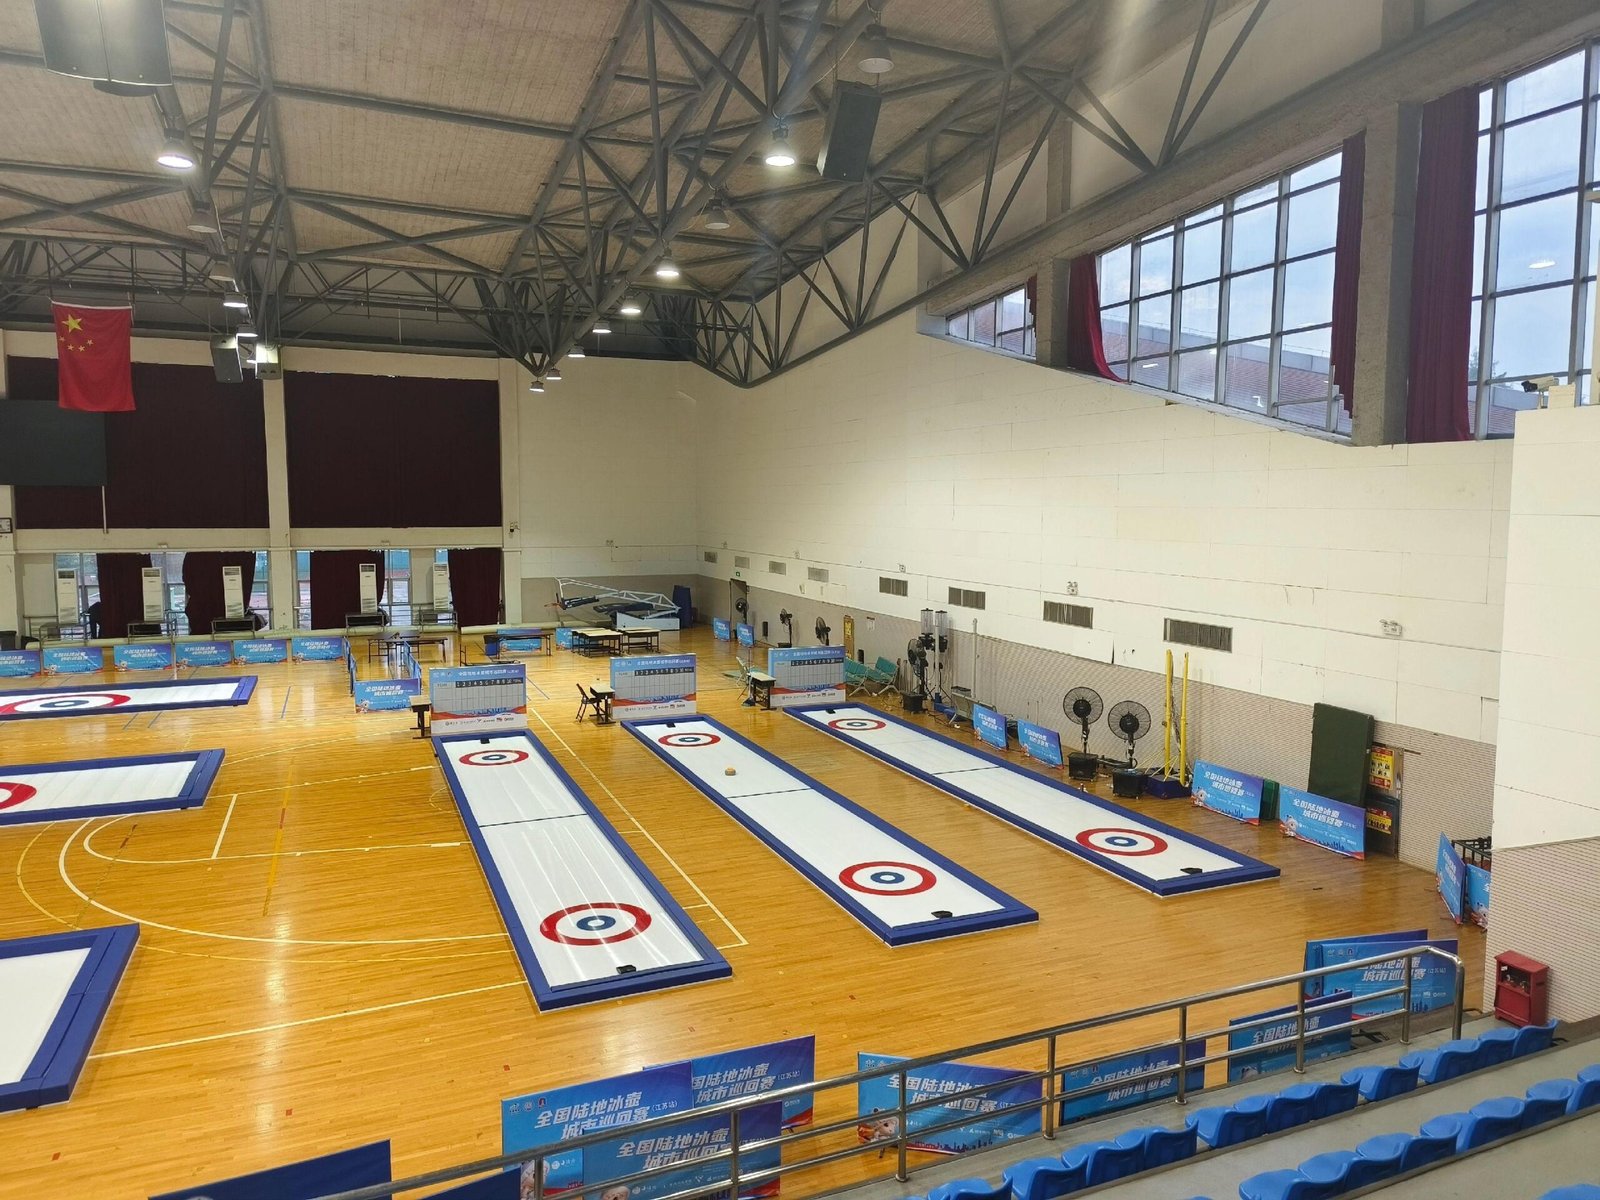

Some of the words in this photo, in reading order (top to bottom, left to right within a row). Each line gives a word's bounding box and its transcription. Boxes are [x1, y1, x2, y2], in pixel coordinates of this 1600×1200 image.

[1251, 1015, 1321, 1045] 全国陆地壶
[695, 1075, 777, 1104] 城市巡回赛
[534, 1091, 643, 1129] 全国陆地冰壶
[616, 1127, 731, 1158] 全国陆地冰壶
